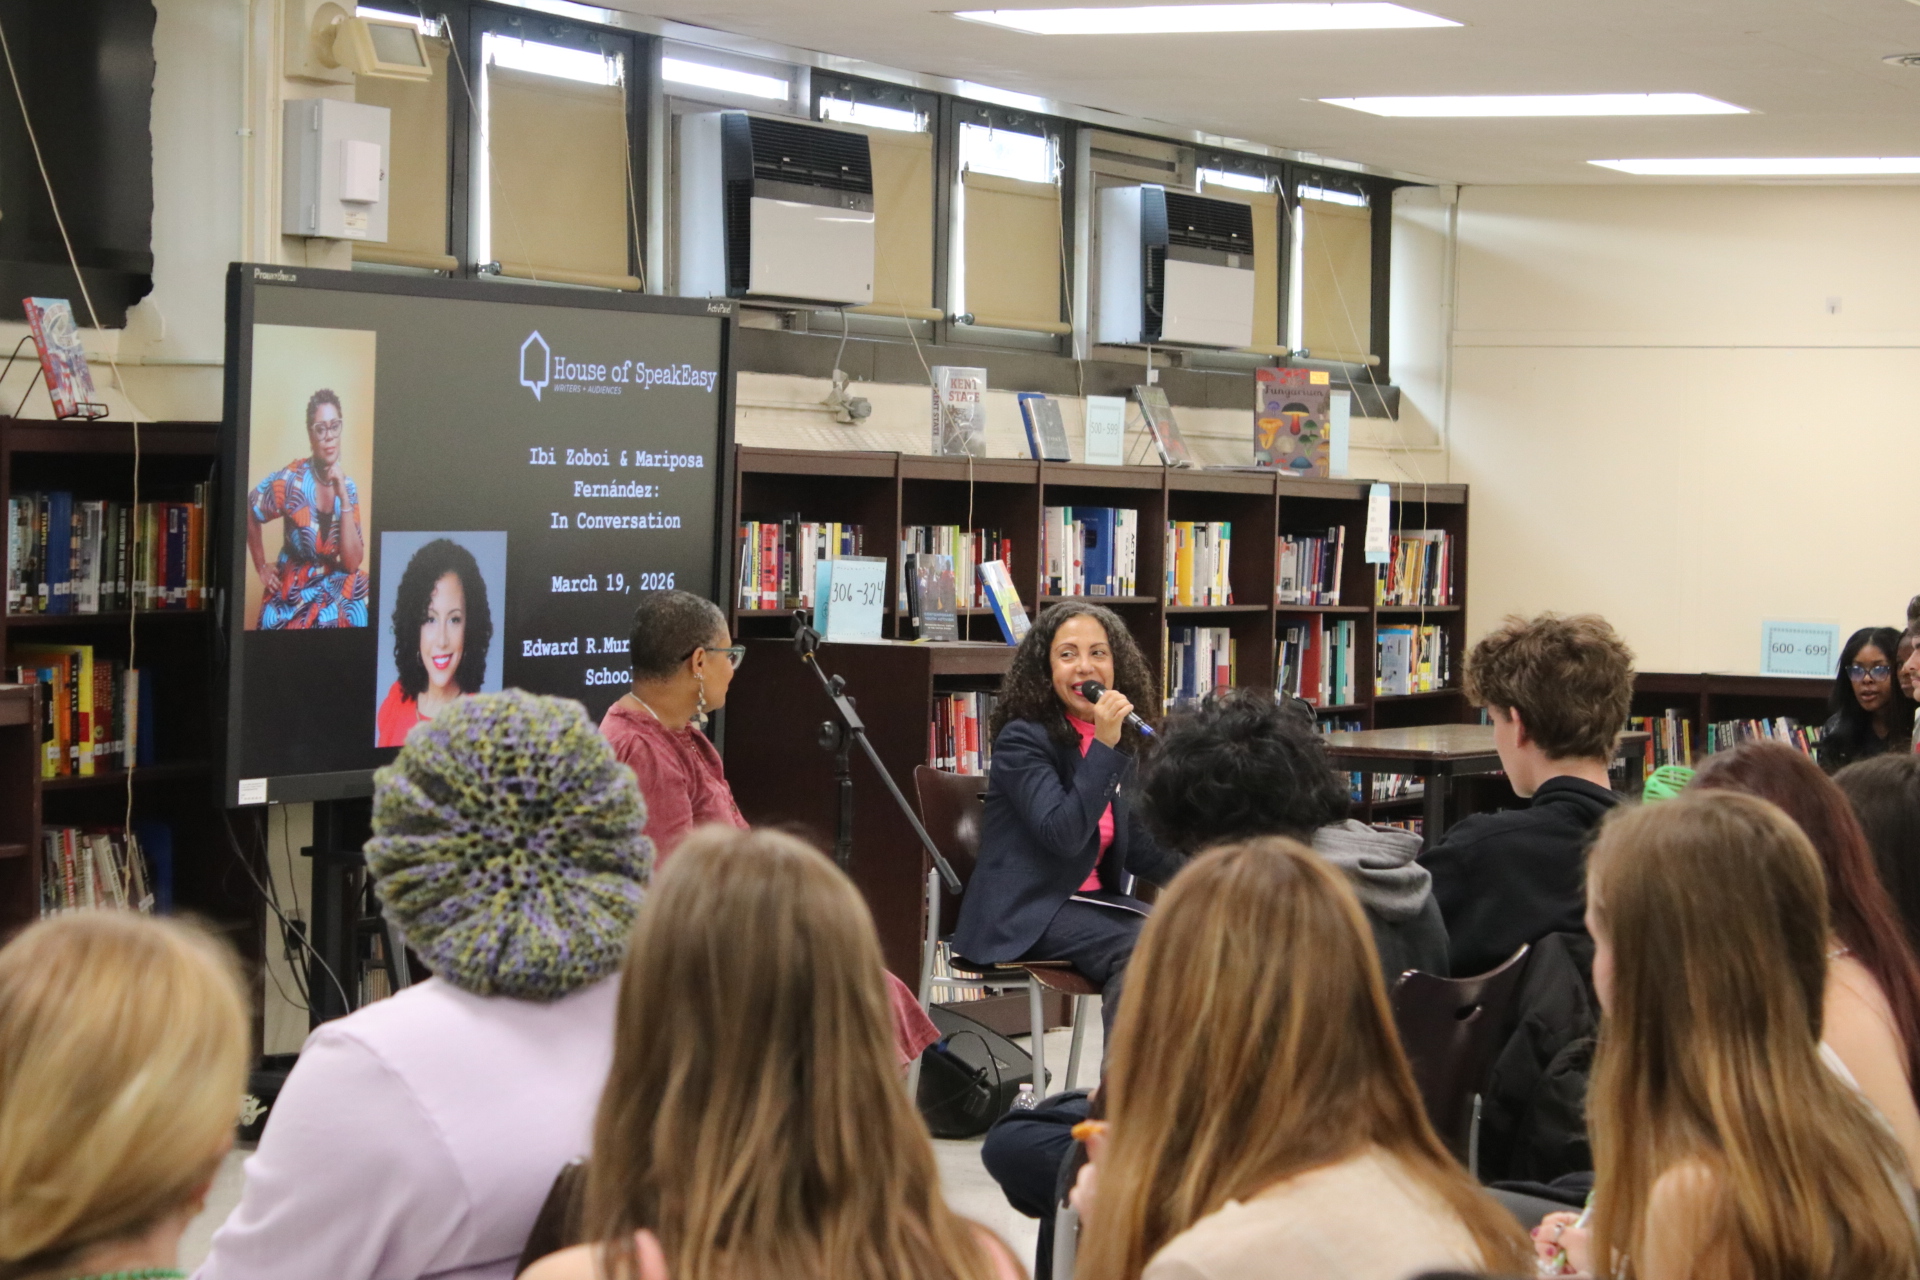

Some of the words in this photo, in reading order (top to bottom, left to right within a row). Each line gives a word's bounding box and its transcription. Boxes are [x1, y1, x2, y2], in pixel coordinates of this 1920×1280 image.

[554, 356, 606, 381] House
[611, 360, 632, 383] of
[635, 361, 718, 393] SpeakEasy
[950, 377, 977, 390] KENT
[554, 384, 581, 393] WRITERS
[587, 385, 622, 395] AUDIENCES
[1264, 384, 1324, 399] Fungarium
[529, 447, 557, 465] Ibi
[566, 448, 610, 466] Zoboi
[620, 450, 628, 467] &
[635, 450, 704, 472] Mariposa
[573, 479, 659, 498] Fernández:
[550, 512, 568, 529] In
[577, 511, 681, 529] Conversation
[551, 574, 598, 593] March
[606, 573, 631, 594] 19,
[640, 572, 675, 591] 2026
[522, 637, 579, 657] Edward
[586, 637, 630, 654] R.Mur
[1771, 642, 1794, 654] 600
[1805, 644, 1828, 656] 699
